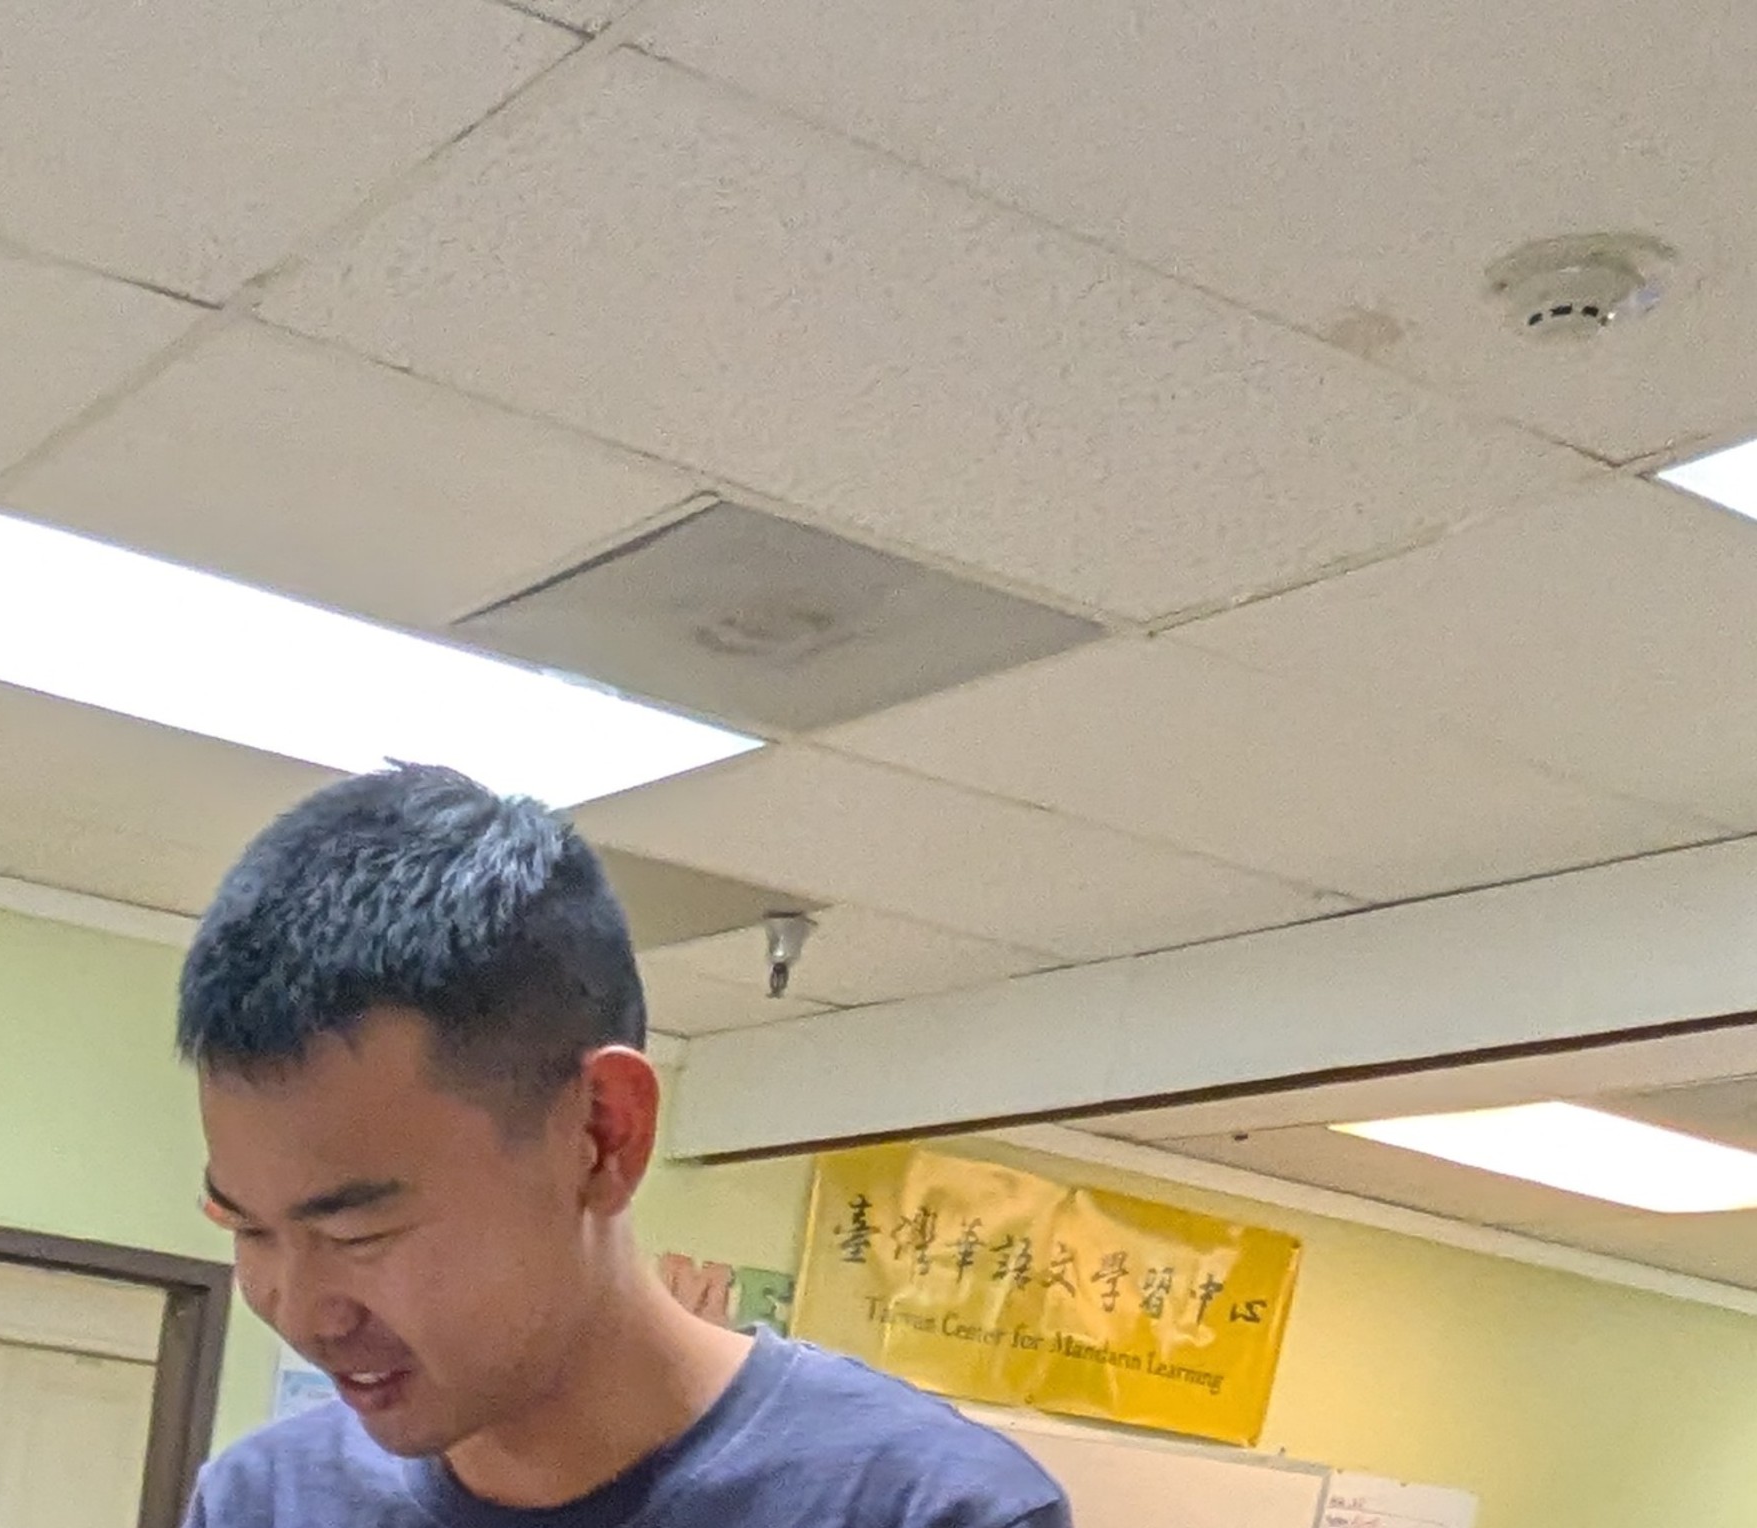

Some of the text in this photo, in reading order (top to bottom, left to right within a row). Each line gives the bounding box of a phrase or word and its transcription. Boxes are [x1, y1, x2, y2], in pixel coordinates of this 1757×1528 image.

[865, 1296, 1225, 1396] Taiwan Center for Mandarin Learning
